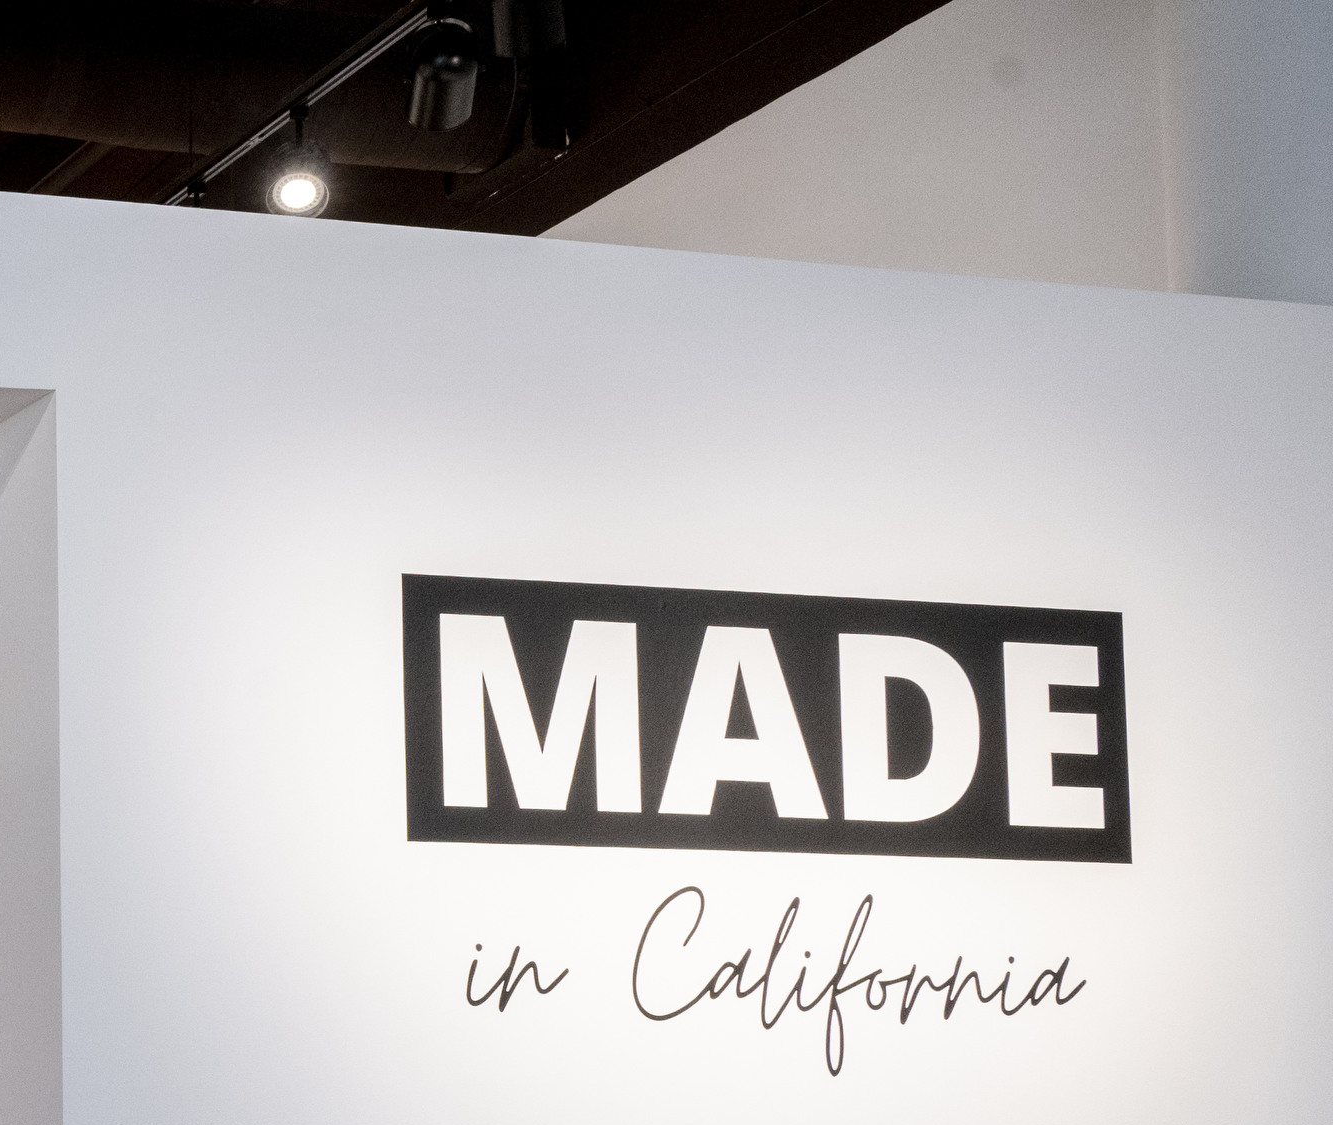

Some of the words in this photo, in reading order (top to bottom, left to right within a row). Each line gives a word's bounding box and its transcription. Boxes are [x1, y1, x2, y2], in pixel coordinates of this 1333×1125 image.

[439, 612, 1106, 830] MADE
[466, 943, 569, 1013] in
[632, 886, 1087, 1077] California
